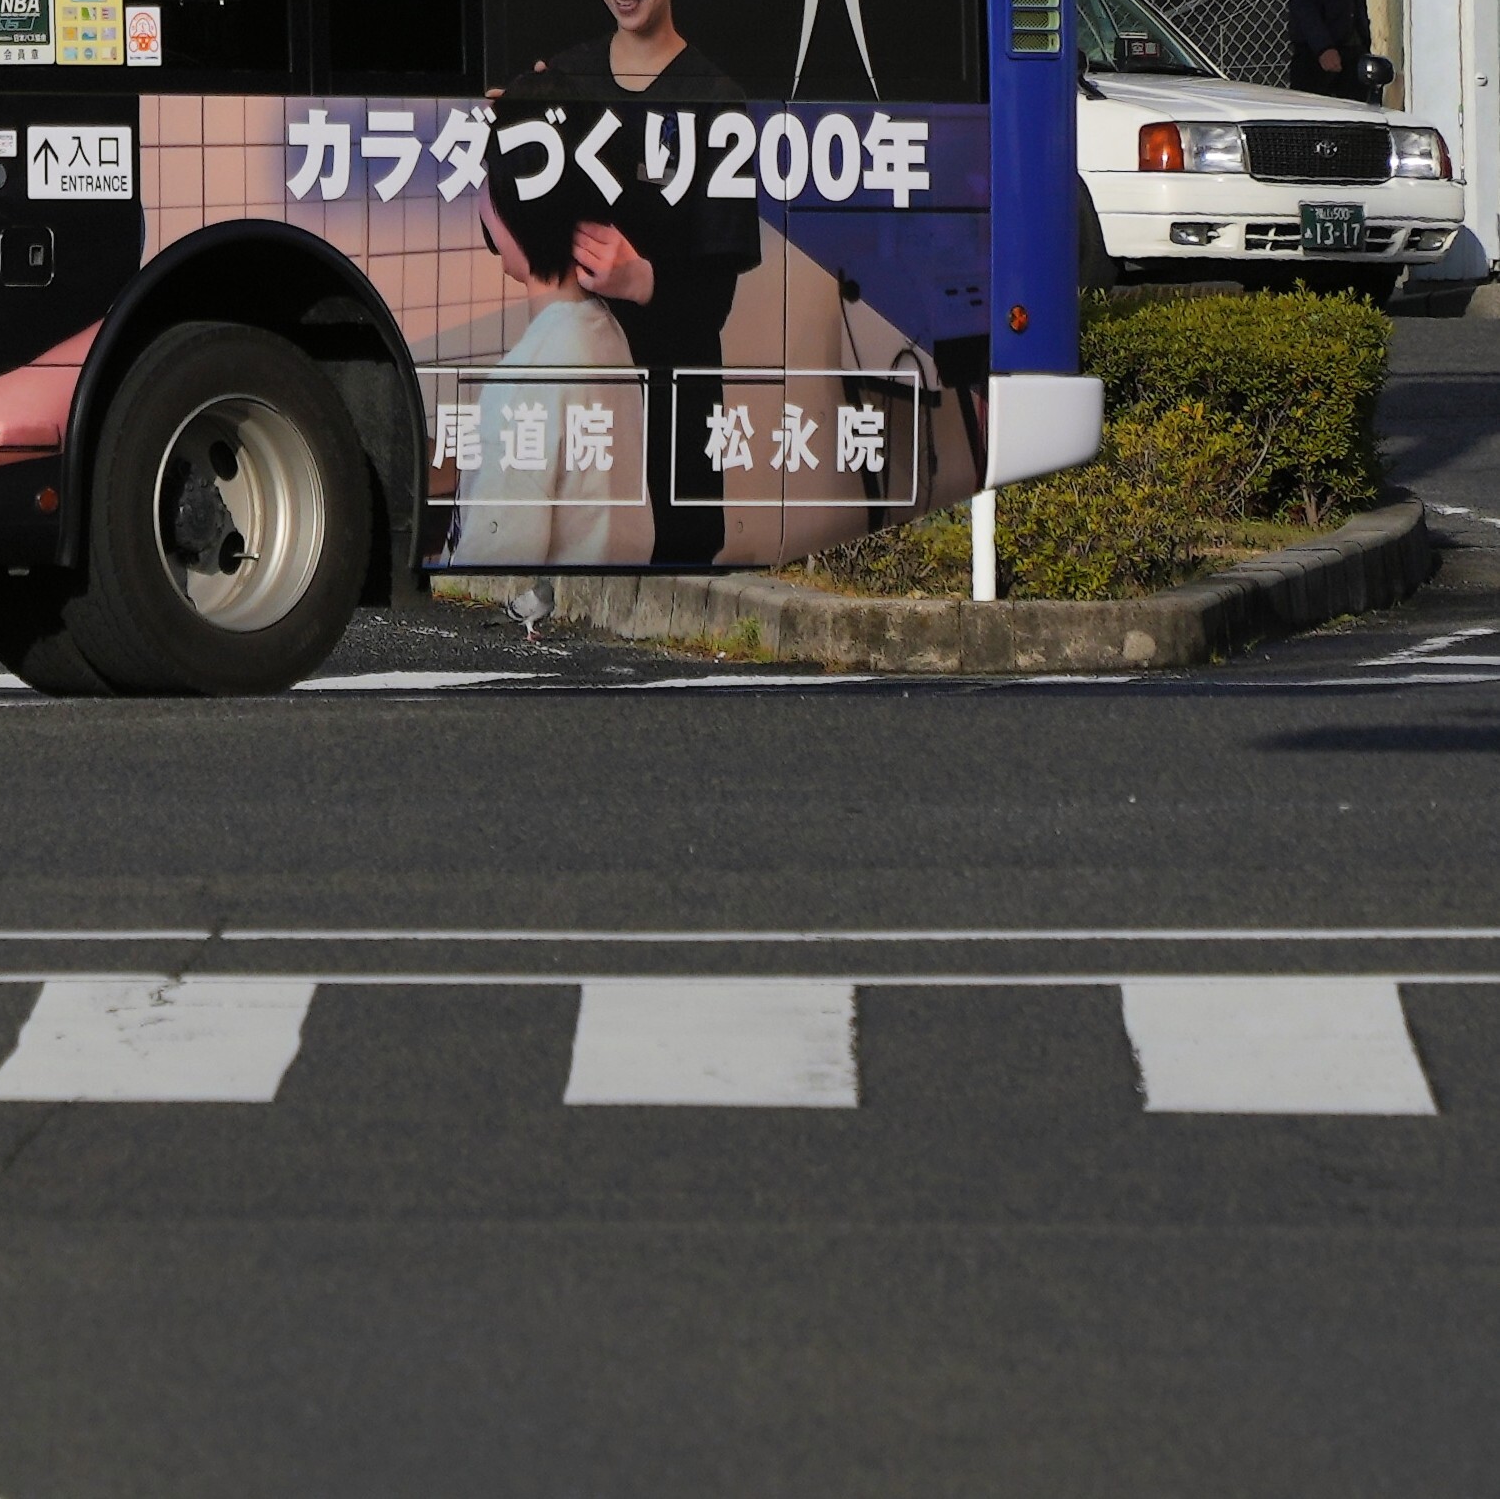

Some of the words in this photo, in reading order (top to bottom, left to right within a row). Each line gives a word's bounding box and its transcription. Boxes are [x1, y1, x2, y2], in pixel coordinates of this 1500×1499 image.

[61, 175, 128, 192] ENTRANCE
[68, 136, 120, 167] 入口
[286, 108, 930, 209] カラダづくり200年
[431, 402, 614, 474] 尾道院
[704, 402, 886, 475] 松永院
